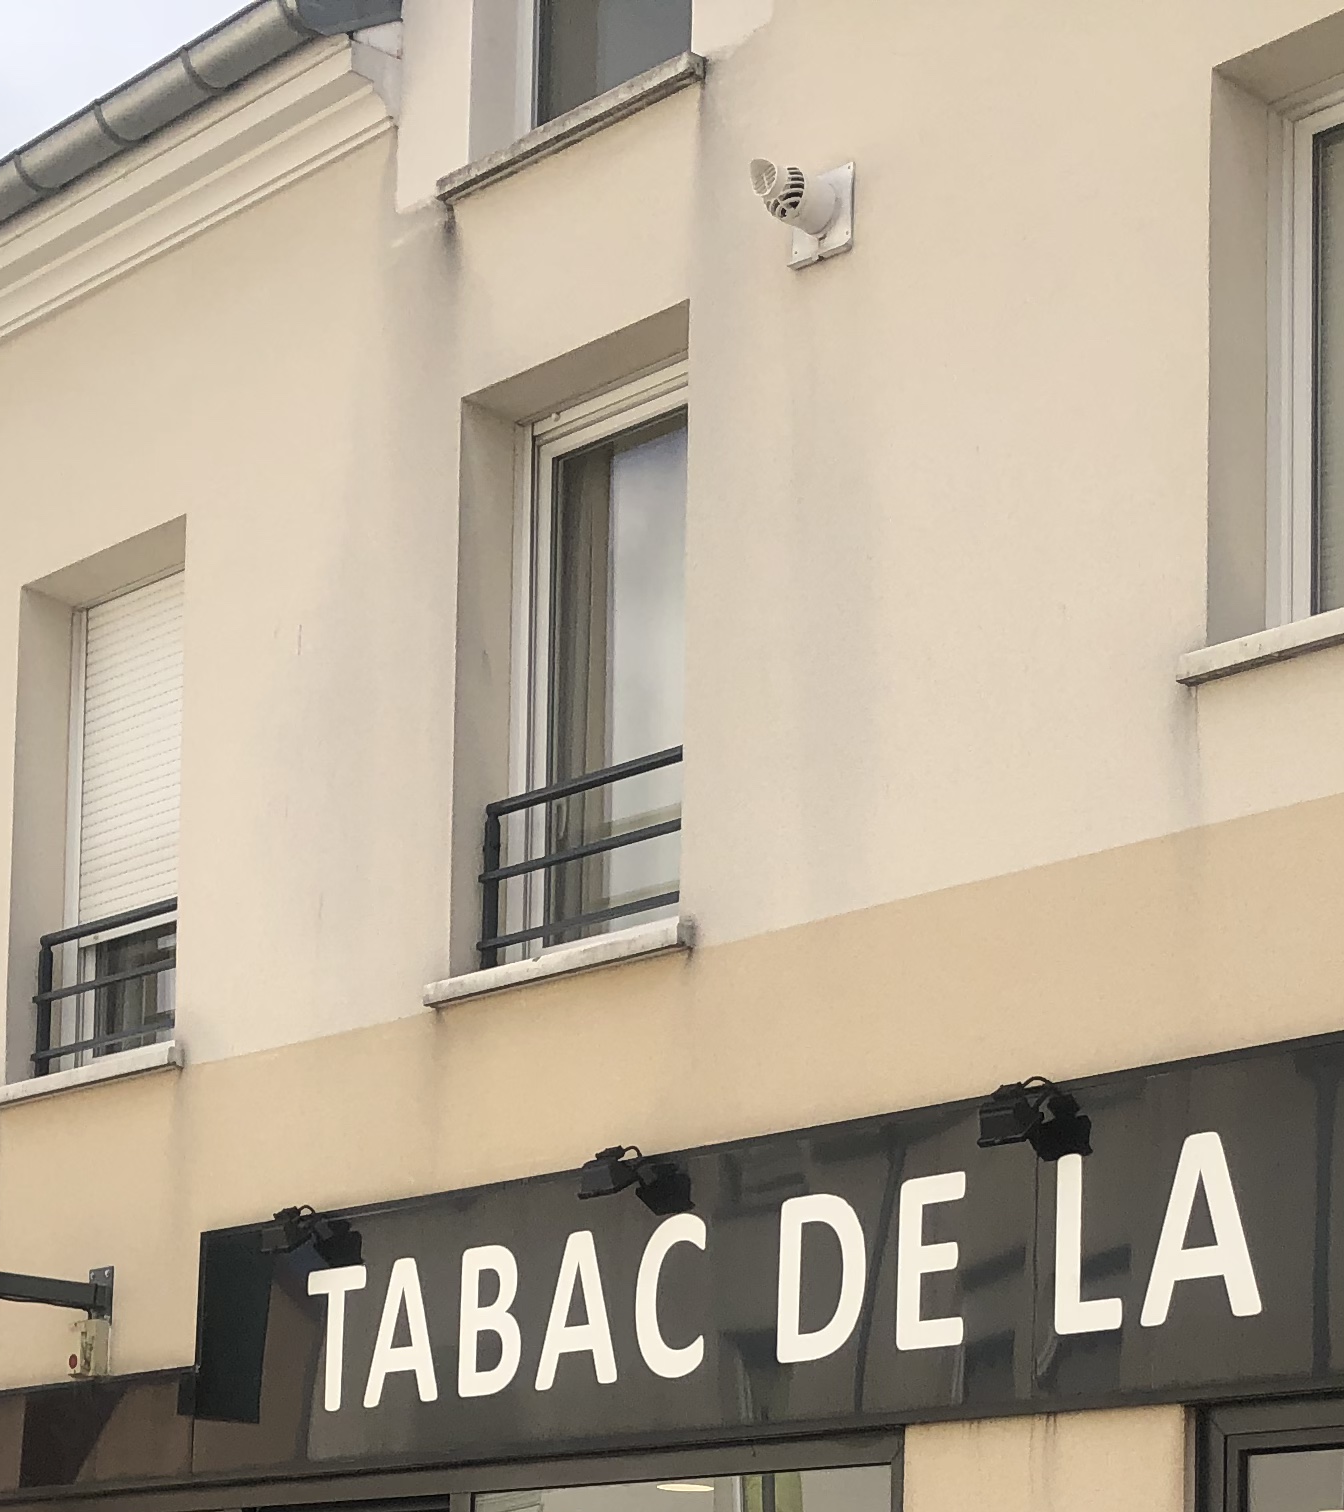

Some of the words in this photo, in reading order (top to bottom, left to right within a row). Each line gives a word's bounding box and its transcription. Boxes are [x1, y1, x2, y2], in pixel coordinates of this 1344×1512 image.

[307, 1213, 708, 1413] TABAC
[776, 1171, 968, 1364] DE
[1053, 1131, 1262, 1337] LA
